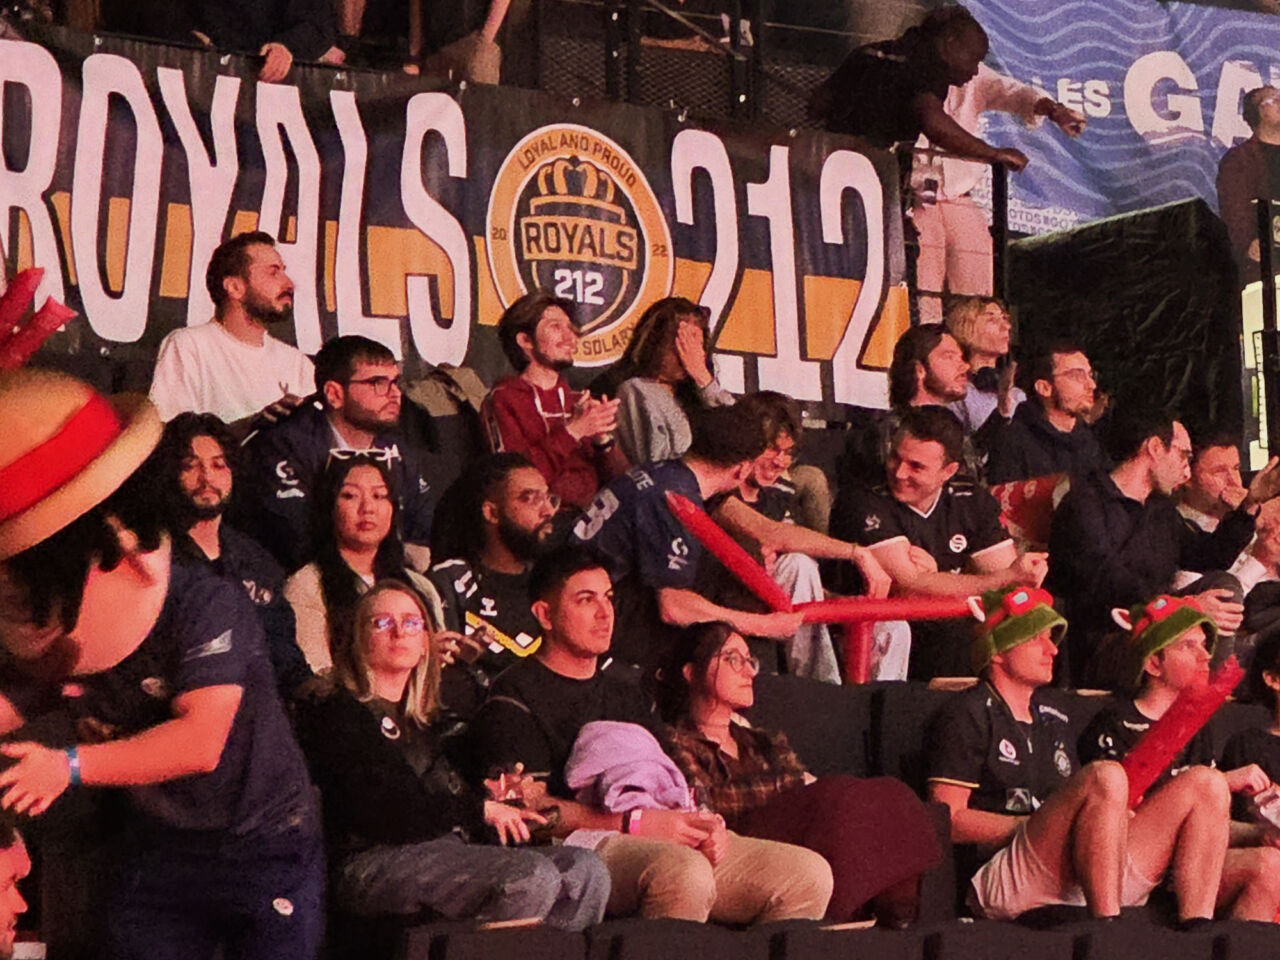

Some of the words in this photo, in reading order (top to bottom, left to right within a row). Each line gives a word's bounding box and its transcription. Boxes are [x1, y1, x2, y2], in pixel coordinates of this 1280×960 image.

[517, 136, 559, 170] LOYAL
[559, 133, 590, 152] AND
[591, 142, 637, 188] PROUD
[0, 39, 471, 368] ROYALS
[671, 129, 890, 409] 212
[491, 226, 508, 242] 20
[524, 221, 636, 263] ROYALS
[652, 242, 669, 258] 22
[554, 268, 606, 306] 212
[582, 321, 635, 357] SOLARY
